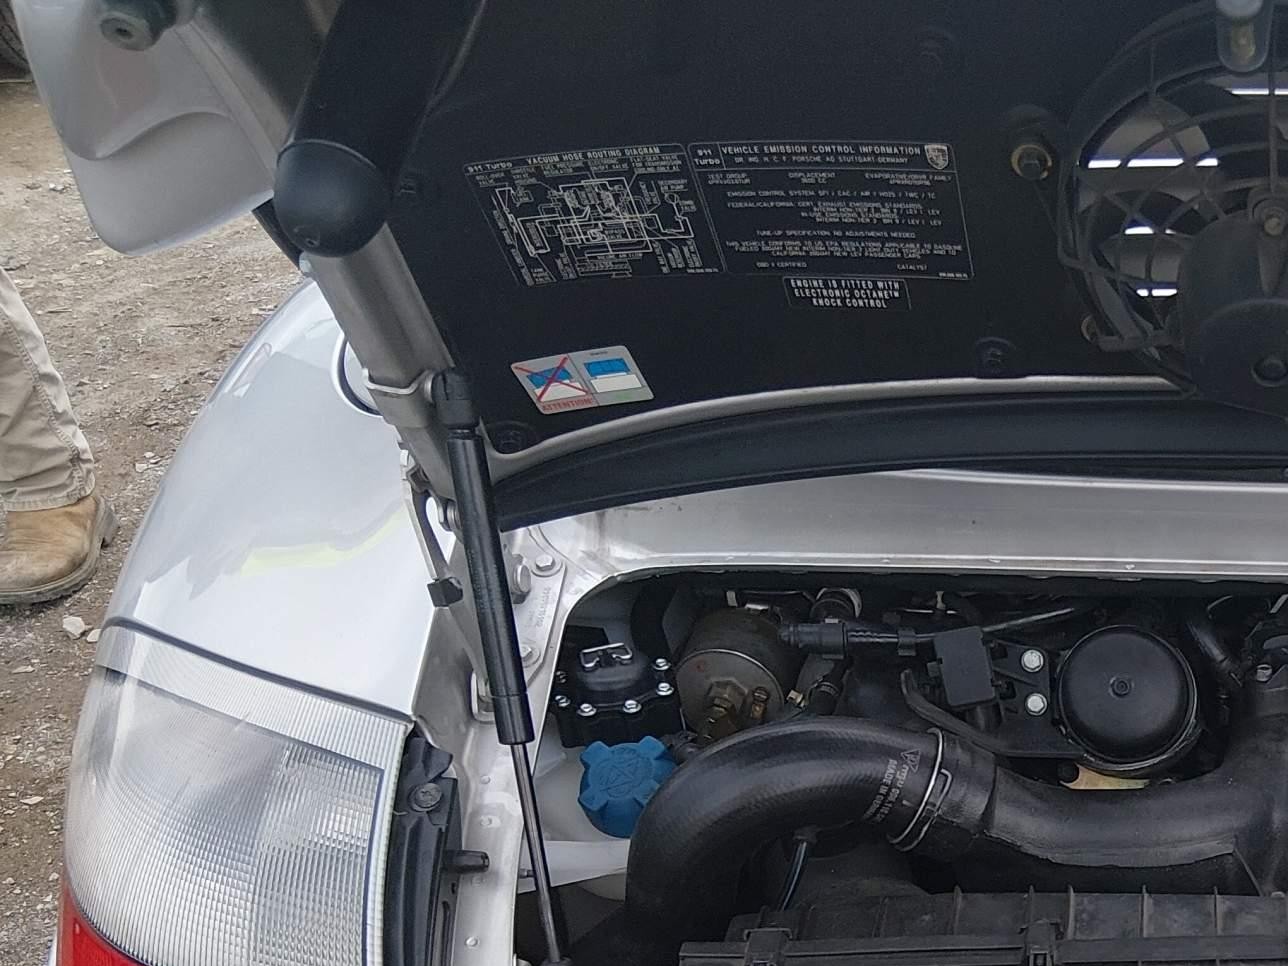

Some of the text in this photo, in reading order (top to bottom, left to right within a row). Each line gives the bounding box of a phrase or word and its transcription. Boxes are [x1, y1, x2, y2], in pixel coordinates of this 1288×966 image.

[526, 154, 560, 164] VACUUM
[562, 152, 584, 162] HOSE
[586, 150, 622, 158] ROUTING
[625, 146, 660, 156] DIAGRAM
[722, 146, 921, 155] VEHICLE EMISSION CONTROL INFORMATION
[694, 158, 721, 166] Turbo
[467, 162, 513, 173] 911 Turbo
[790, 279, 900, 290] ENGINE IS FITTED WITH
[794, 288, 851, 298] ELECTRONIC
[812, 298, 888, 308] KNOCK CONTROL
[883, 759, 898, 785] MADE
[879, 785, 889, 795] IN
